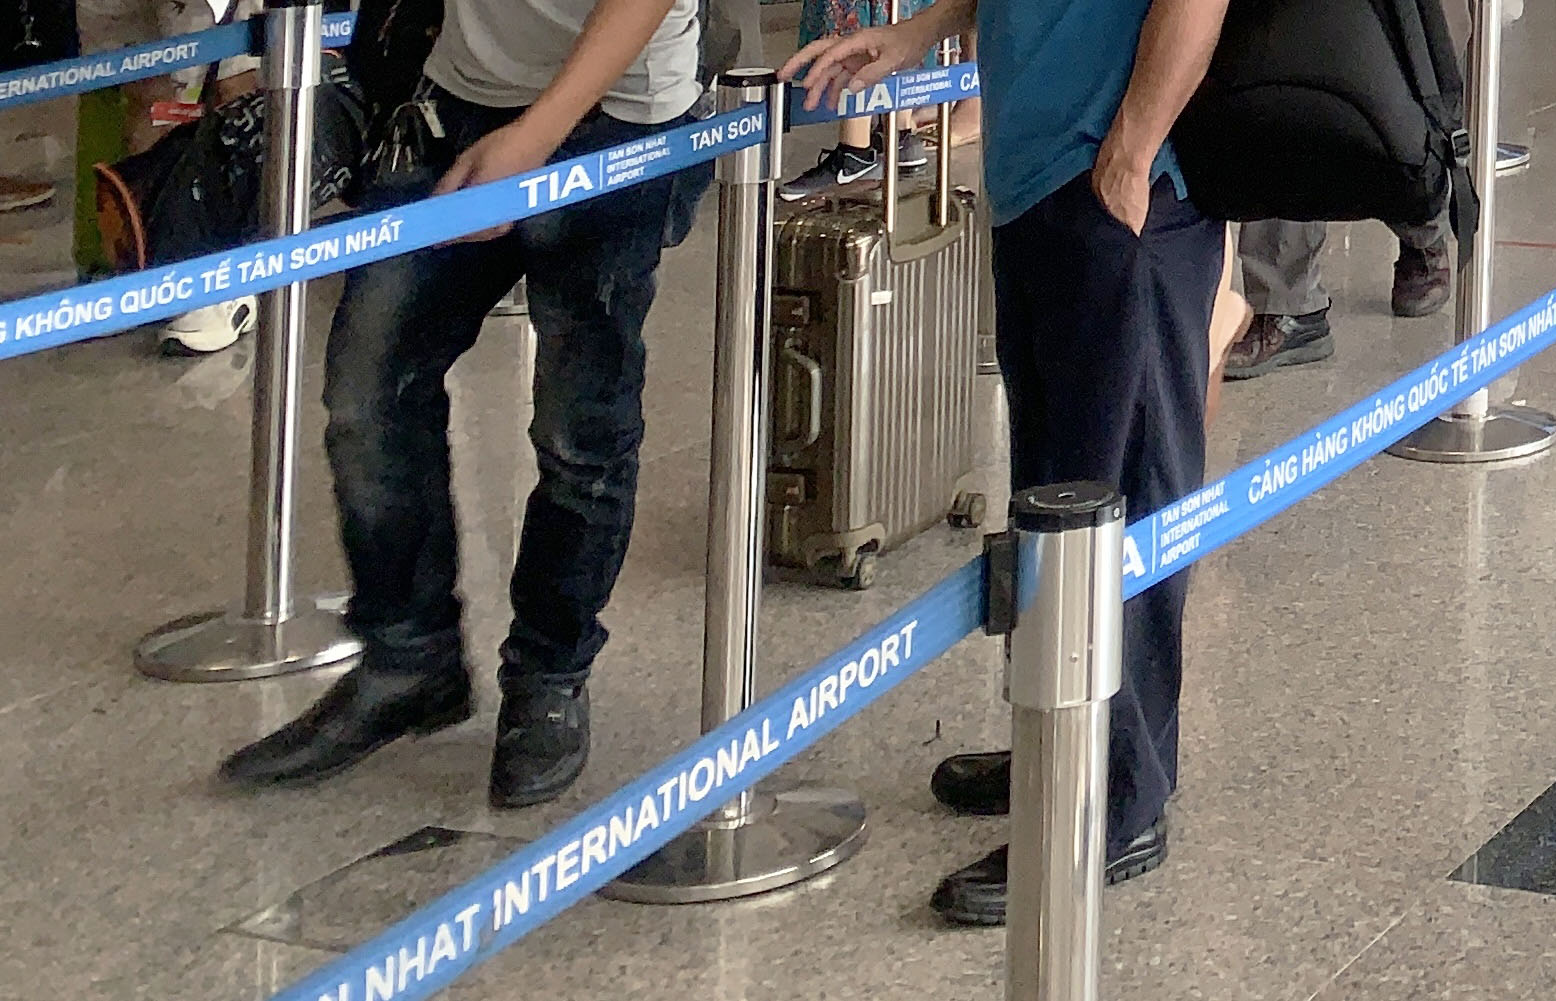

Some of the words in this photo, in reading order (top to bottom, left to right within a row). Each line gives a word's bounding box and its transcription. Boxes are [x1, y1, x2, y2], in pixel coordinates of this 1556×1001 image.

[0, 61, 117, 99] ERNATIONAL
[120, 41, 200, 73] AIRPORT
[690, 126, 723, 152] TAN
[727, 113, 763, 140] SON
[607, 147, 671, 174] INTERNATIONAL
[519, 164, 594, 209] TIA
[15, 295, 113, 340] KHÔNG
[120, 269, 193, 314] QUỐC
[200, 258, 232, 295] TẾ
[237, 251, 284, 283] TÂN
[290, 236, 340, 270] SƠN
[345, 214, 404, 256] NHẤT
[1248, 460, 1298, 504] CẢNG
[1302, 432, 1348, 475] HÀNG
[1351, 394, 1406, 449] KHÔNG
[1408, 362, 1449, 413] QUỐC
[1451, 343, 1470, 387] TẾ
[1471, 338, 1497, 375] TÂN
[1499, 324, 1527, 358] SƠN
[1160, 507, 1180, 528] TAN
[1180, 497, 1201, 519] SON
[1201, 481, 1226, 508] NHAT
[1160, 500, 1230, 548] INTERNATIONAL
[1160, 532, 1201, 569] AIRPORT
[364, 902, 481, 1001] NHAT
[491, 727, 780, 934] INTERNATIONAL
[785, 618, 920, 741] AIRPORT
